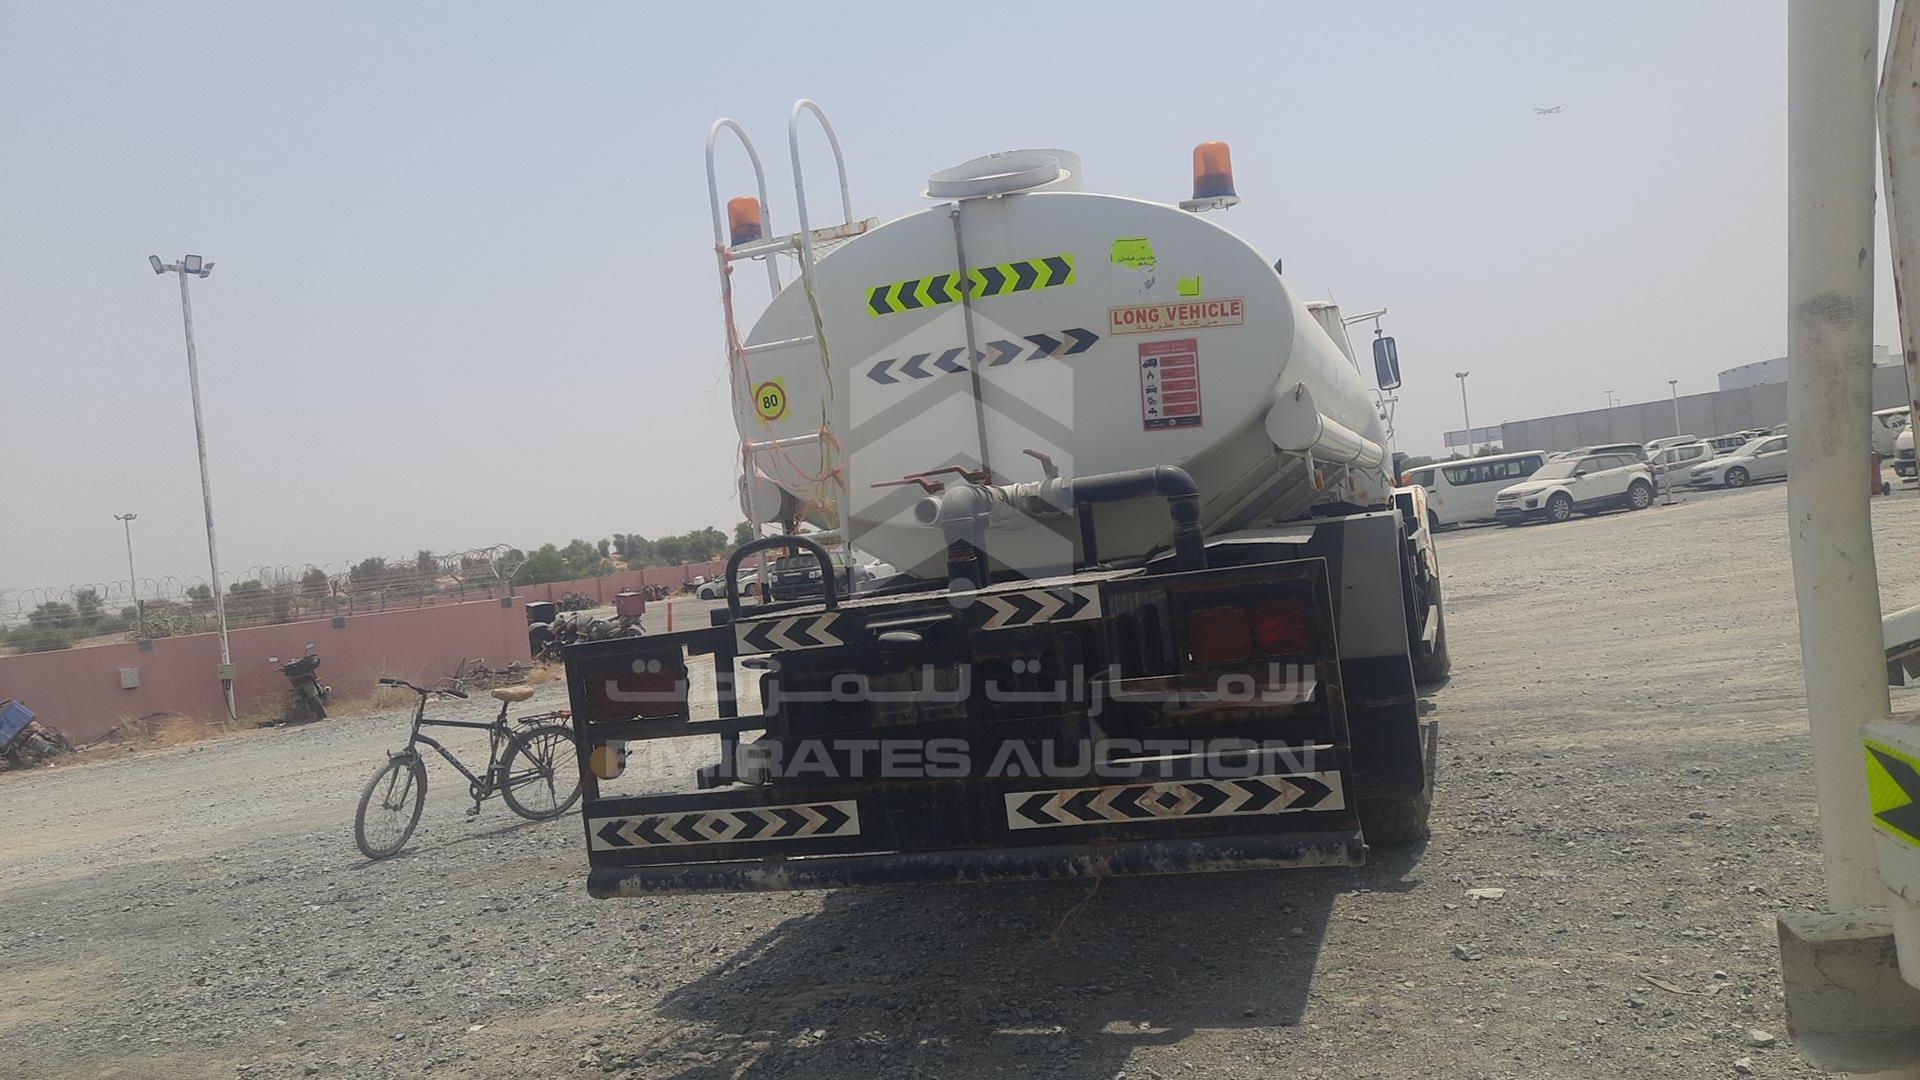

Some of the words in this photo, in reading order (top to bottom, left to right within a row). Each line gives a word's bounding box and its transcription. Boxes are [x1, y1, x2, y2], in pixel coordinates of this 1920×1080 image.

[1113, 308, 1160, 326] LONG
[1166, 301, 1241, 321] VEHICLE
[762, 393, 779, 410] 80
